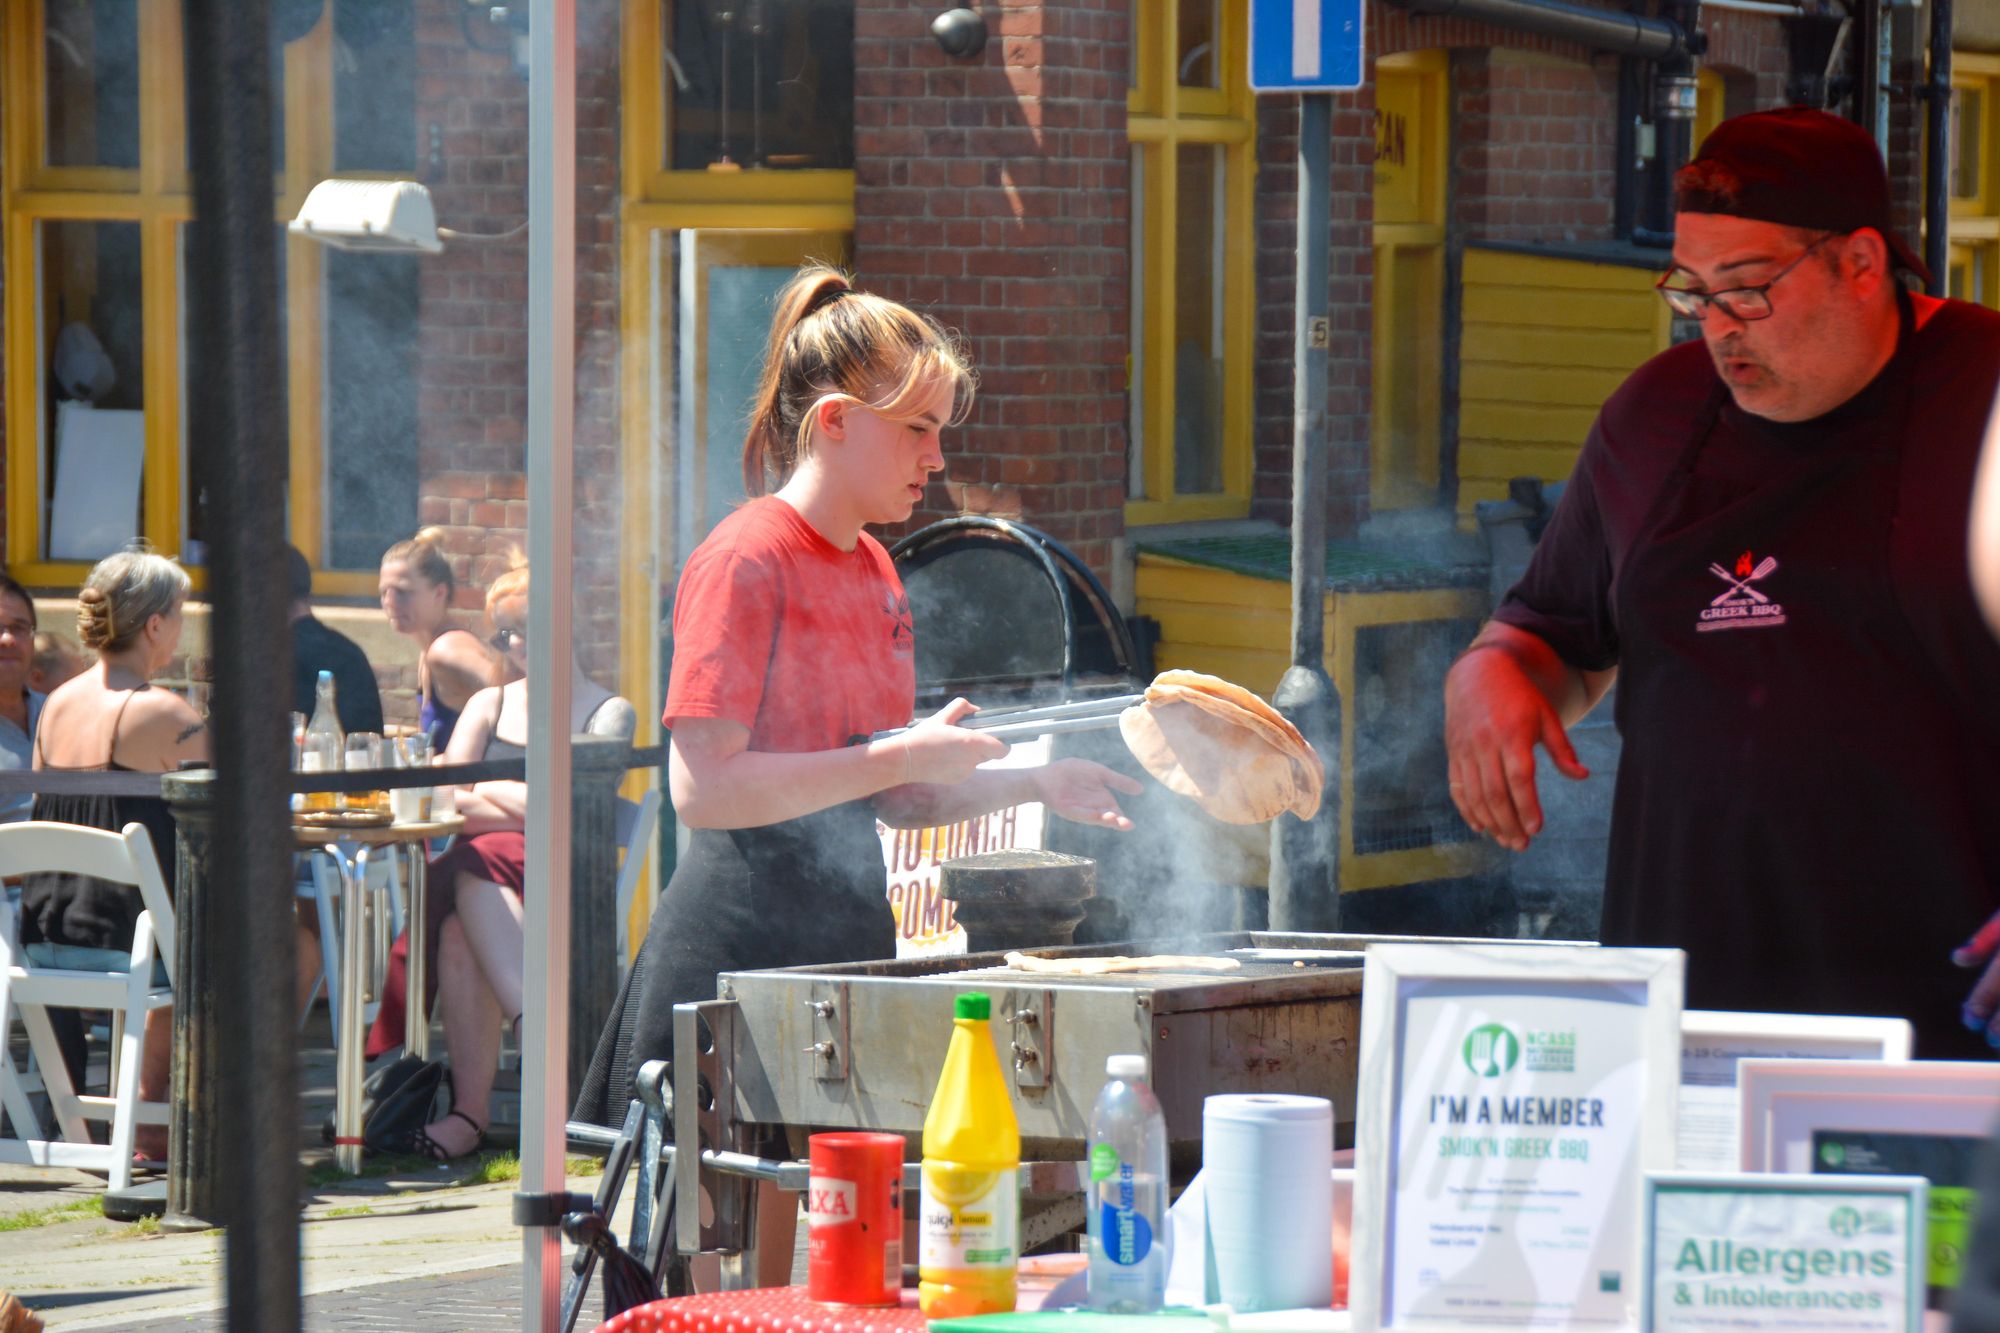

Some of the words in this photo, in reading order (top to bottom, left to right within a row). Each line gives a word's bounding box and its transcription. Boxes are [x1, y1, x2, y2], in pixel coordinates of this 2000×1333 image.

[1314, 320, 1326, 342] 5
[1700, 606, 1748, 619] GREEK
[1751, 604, 1781, 616] BBQ
[1526, 1031, 1576, 1046] NCASS
[1429, 1095, 1467, 1123] I'M
[1477, 1096, 1491, 1124] A
[1501, 1096, 1604, 1127] MEMBER
[1439, 1136, 1498, 1157] SMOK'N
[1504, 1138, 1551, 1159] GREEK
[1558, 1139, 1588, 1162] BBQ
[1674, 1238, 1894, 1284] Allergens
[1674, 1282, 1693, 1306] &
[1704, 1284, 1883, 1309] Intolerances
